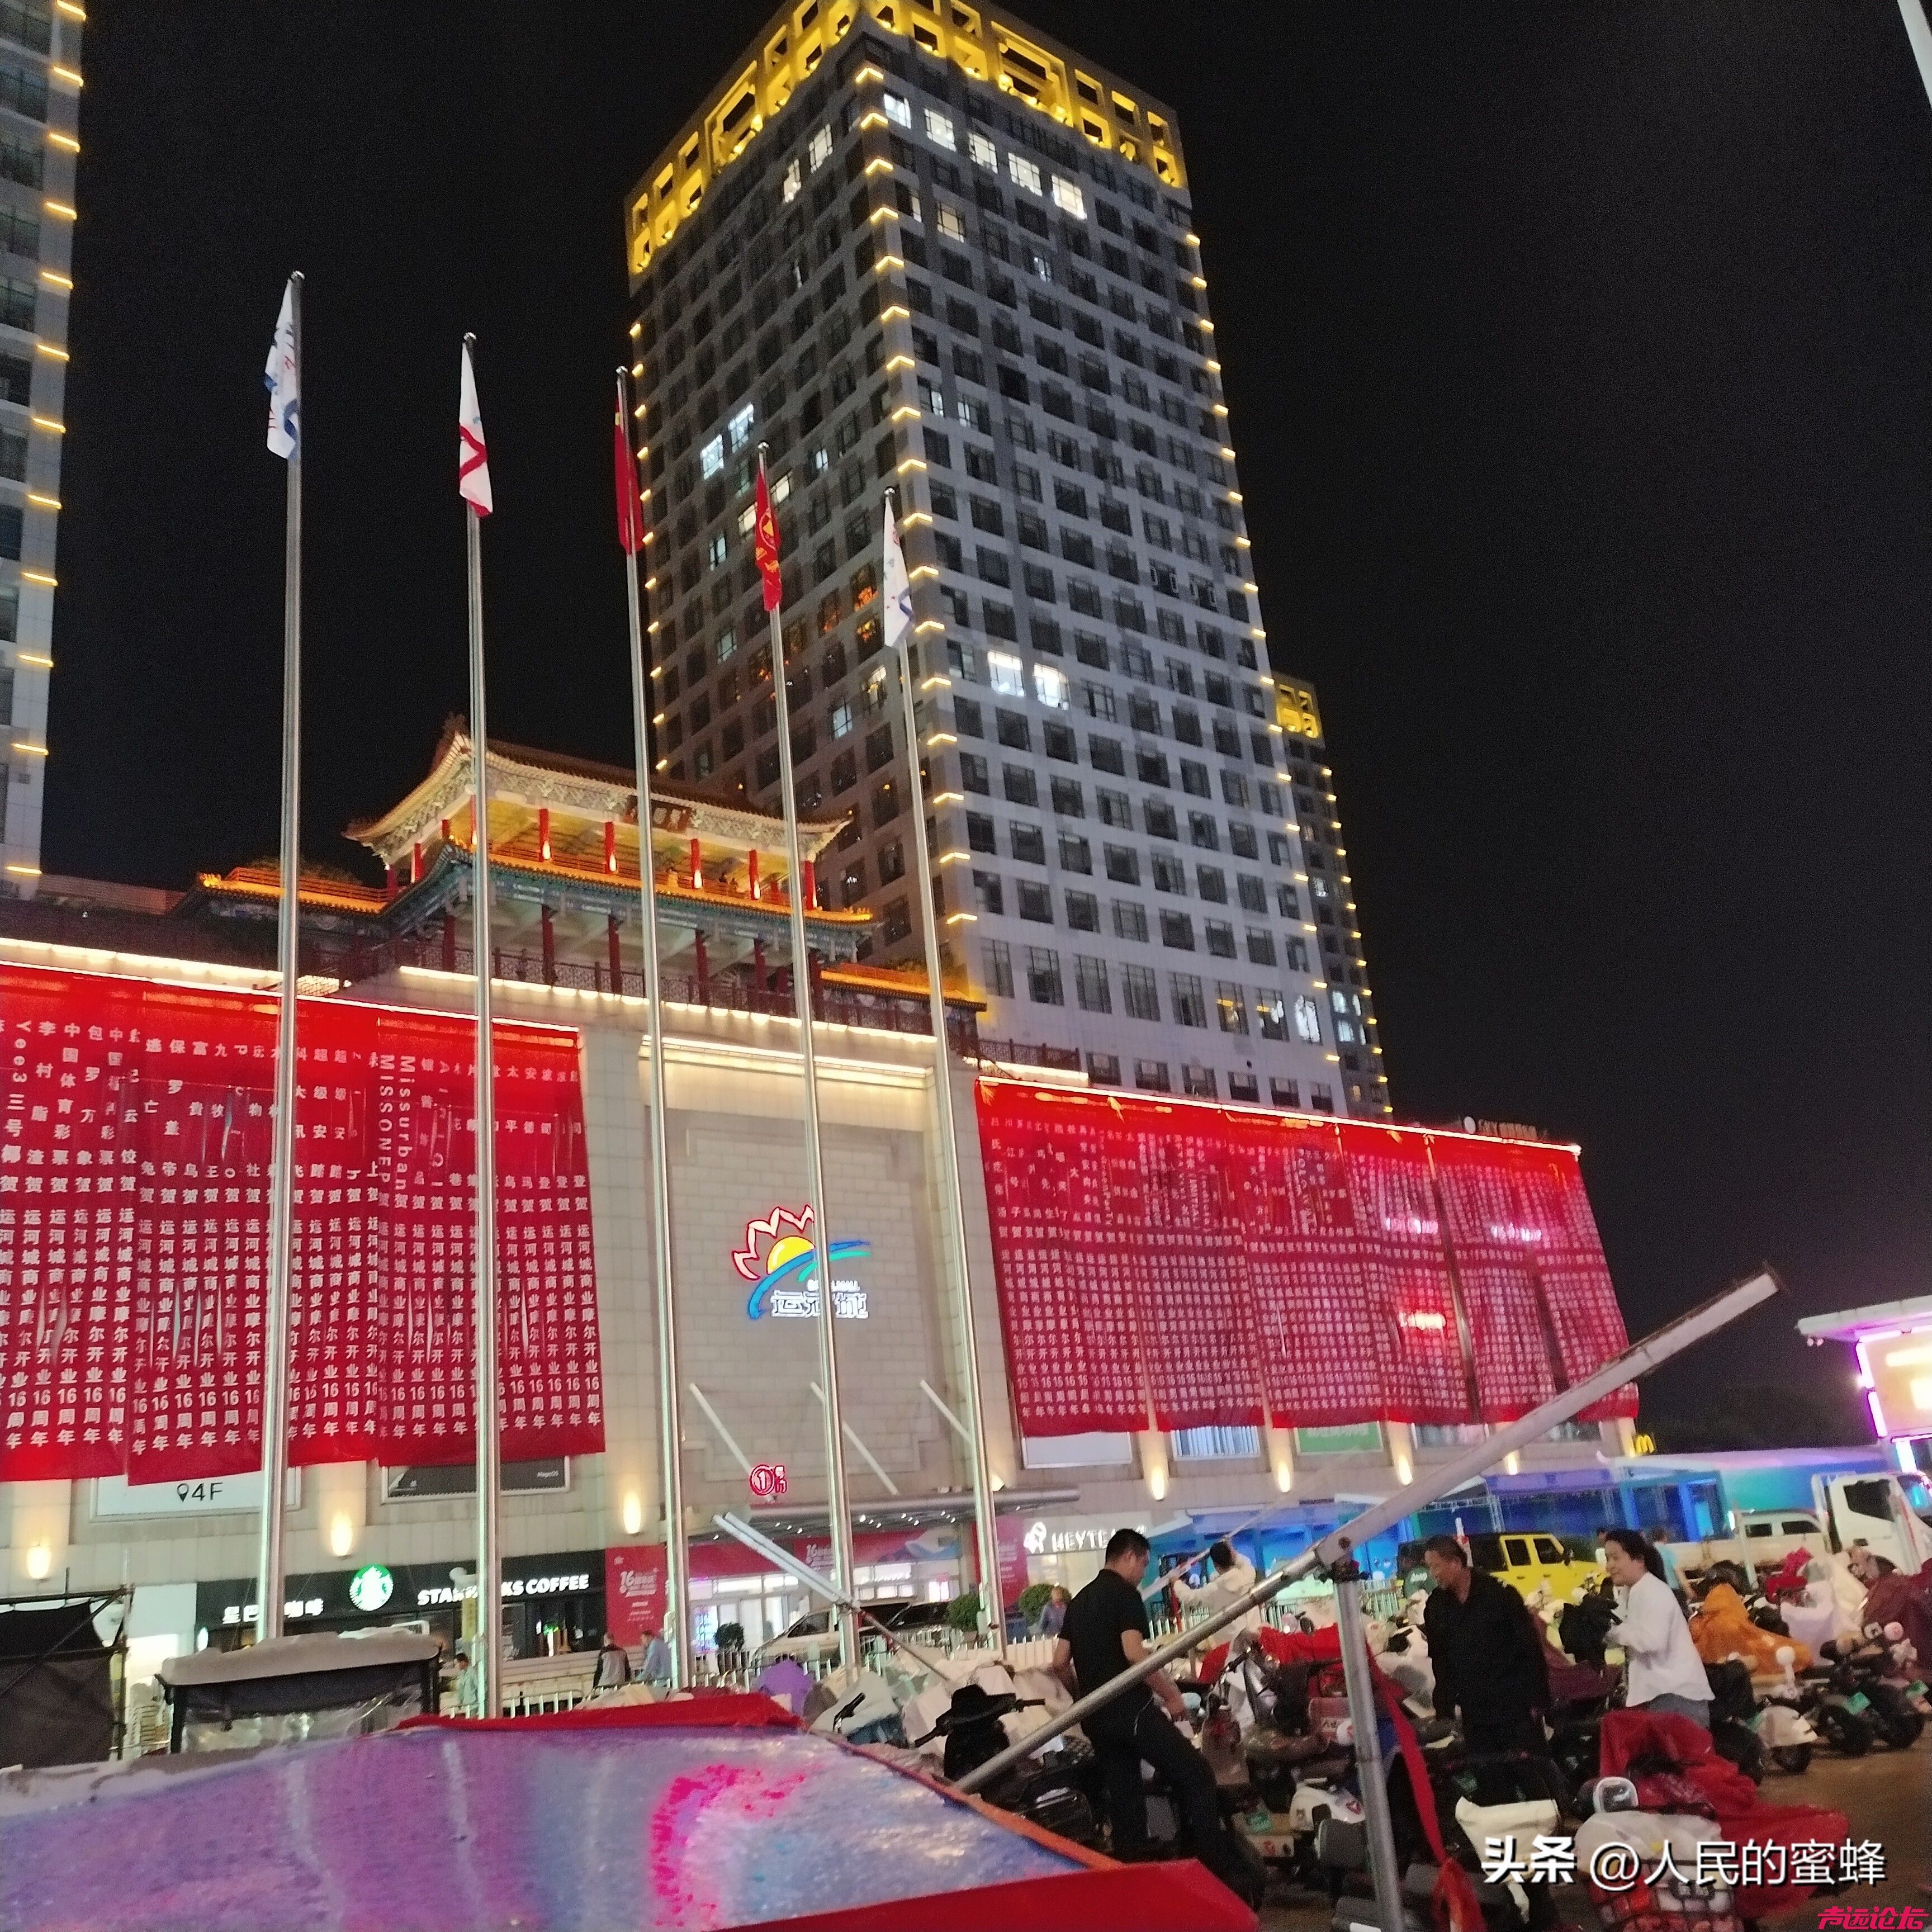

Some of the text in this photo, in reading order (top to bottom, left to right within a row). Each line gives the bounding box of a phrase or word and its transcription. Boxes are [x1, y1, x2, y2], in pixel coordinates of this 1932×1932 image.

[191, 1482, 224, 1501] 4F
[1052, 1528, 1117, 1552] HEYTE
[525, 1574, 589, 1595] COFFEE
[222, 1598, 324, 1625] 星巴咖啡
